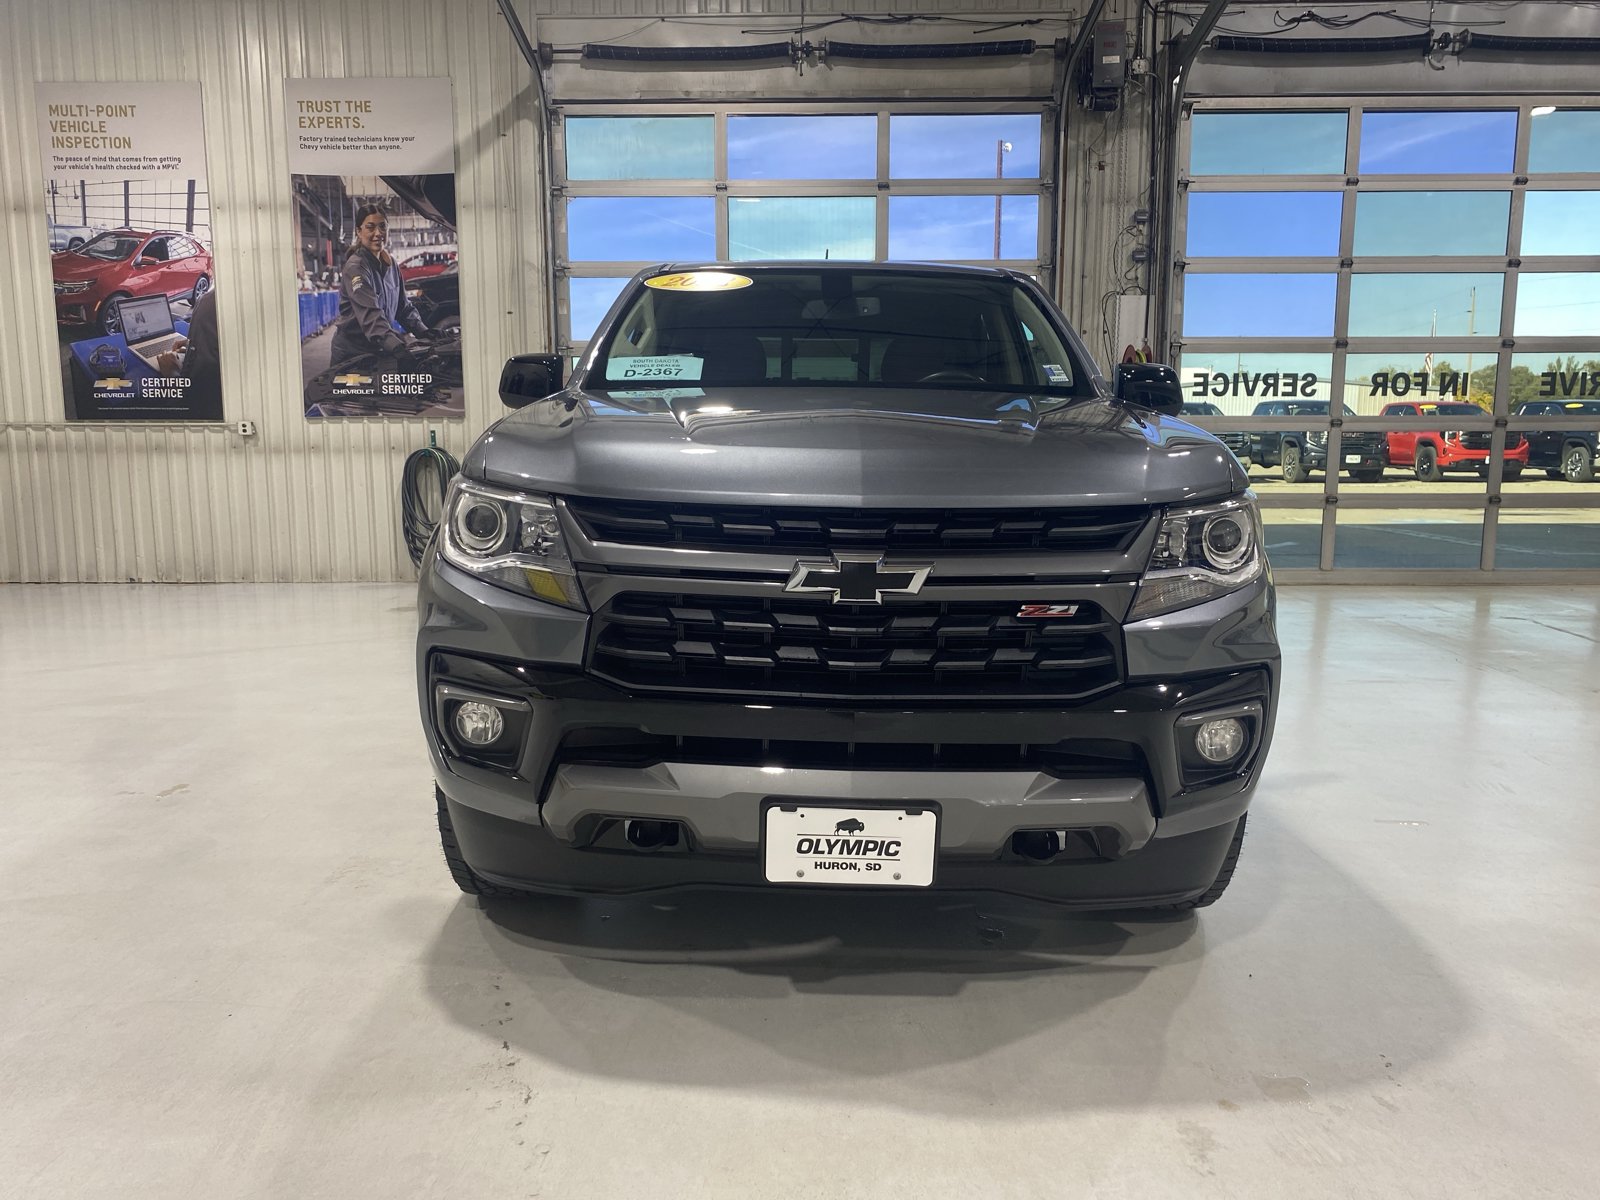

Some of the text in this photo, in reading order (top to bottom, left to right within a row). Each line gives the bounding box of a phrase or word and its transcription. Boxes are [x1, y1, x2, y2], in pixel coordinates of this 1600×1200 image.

[48, 104, 136, 118] MULTI-POINT
[297, 100, 372, 113] TRUST THE
[49, 120, 107, 133] VEHICLE
[298, 116, 365, 129] EXPERTS.
[51, 136, 132, 149] INSPECTION
[299, 135, 322, 143] Factory
[381, 373, 433, 384] CERTIFIED
[623, 368, 684, 378] D-2367
[141, 377, 191, 388] CERTIFIED
[142, 388, 184, 398] SERVICE
[382, 385, 424, 395] SERVICE
[796, 838, 902, 857] OLYMPIC
[814, 861, 882, 872] HURON, SD
